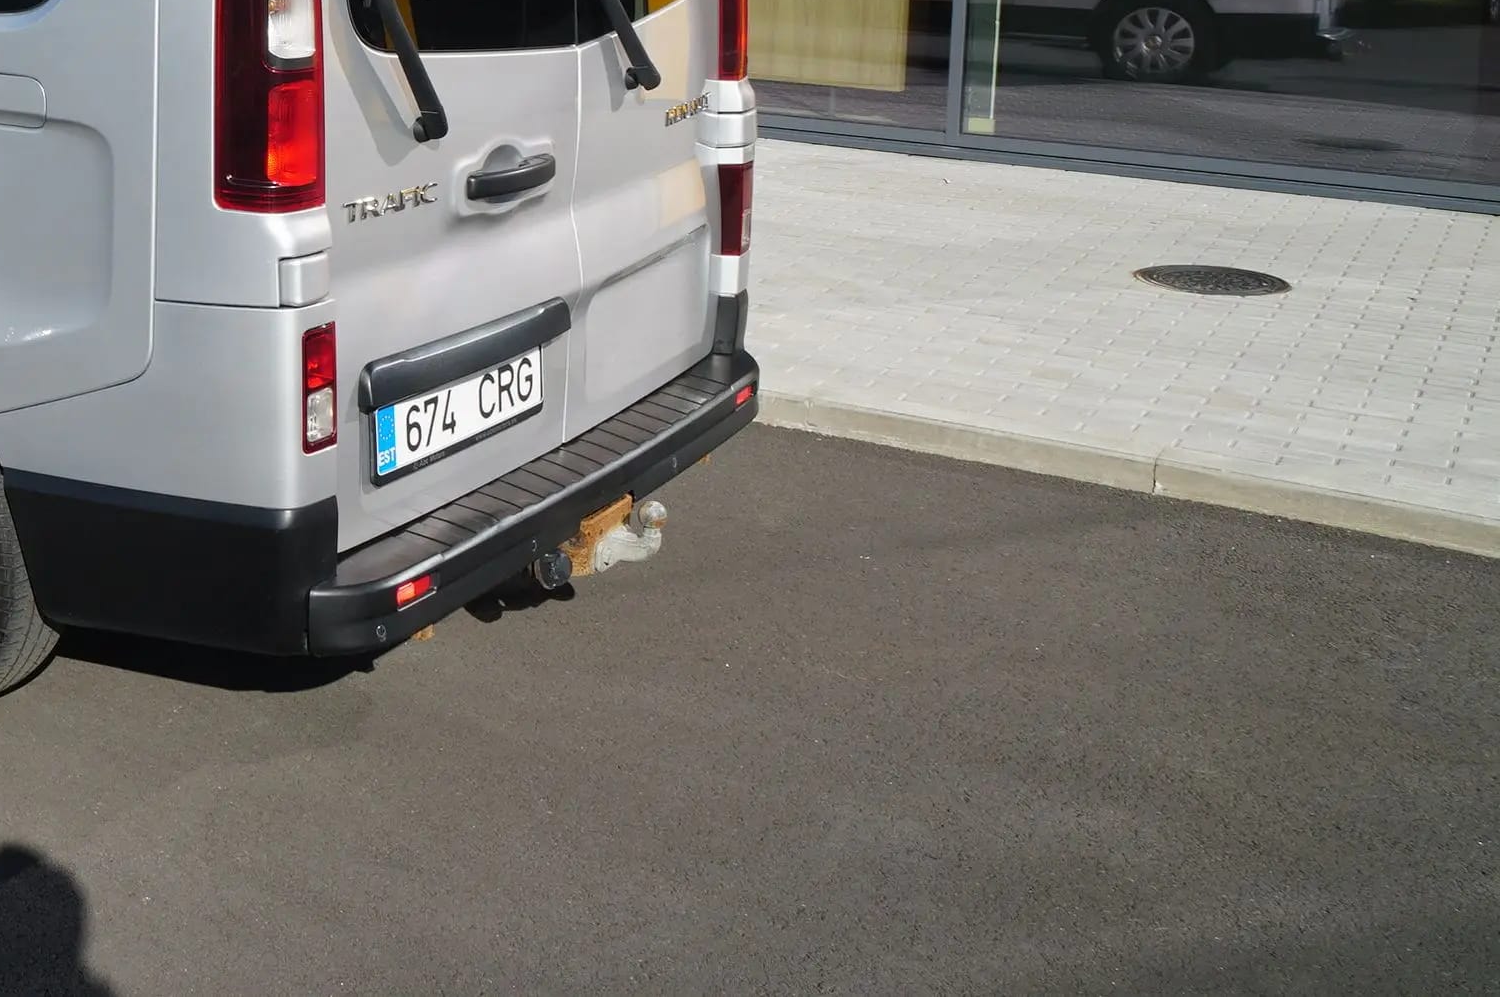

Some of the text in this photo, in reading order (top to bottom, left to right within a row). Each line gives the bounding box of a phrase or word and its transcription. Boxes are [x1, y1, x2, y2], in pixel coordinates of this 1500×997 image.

[343, 182, 438, 223] TRAFIC
[406, 357, 533, 452] 674 CRG
[379, 447, 397, 467] EST
